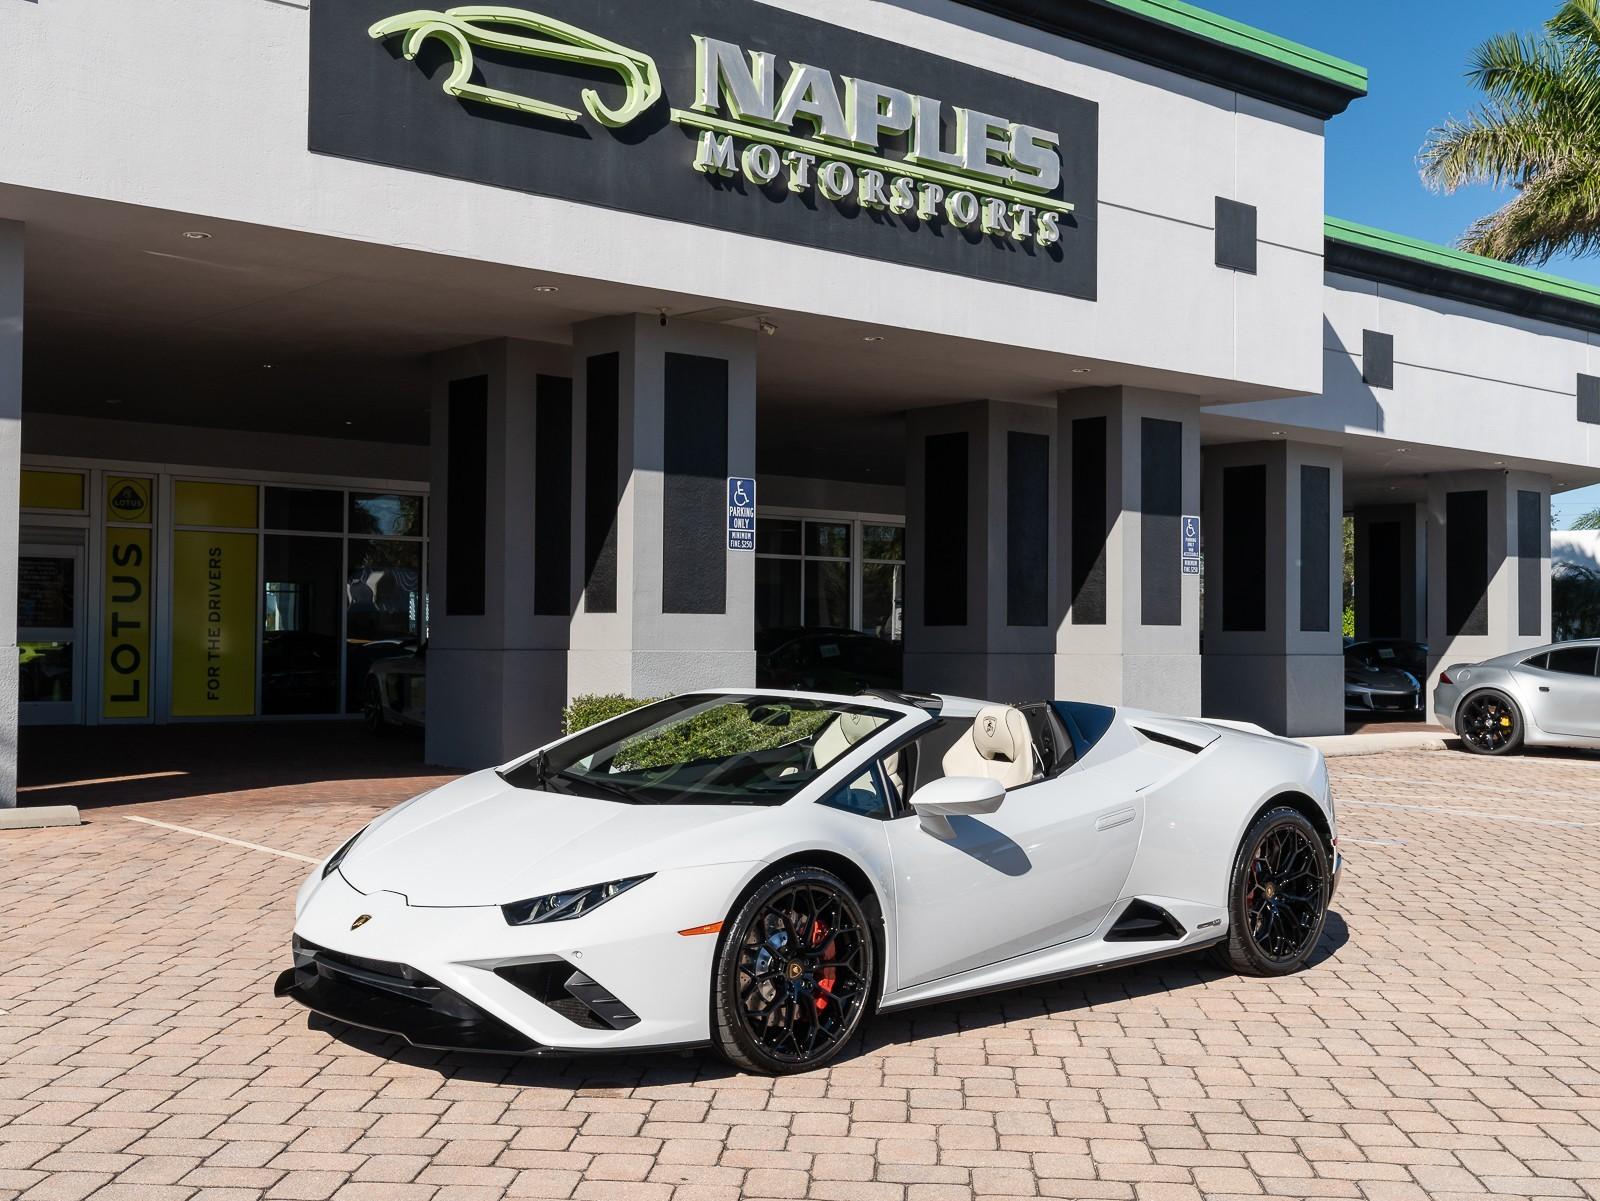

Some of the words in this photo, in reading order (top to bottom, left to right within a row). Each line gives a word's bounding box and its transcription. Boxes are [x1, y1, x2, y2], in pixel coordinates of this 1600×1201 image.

[690, 33, 1061, 194] NAPLES
[692, 130, 1060, 247] MOTORSPORTS
[115, 499, 141, 507] LOTUS
[729, 506, 754, 518] PARKING
[733, 518, 750, 529] ONLY
[208, 547, 222, 622] DRIVERS
[110, 543, 143, 702] LOTUS
[208, 628, 220, 661] THE
[207, 667, 220, 701] FOR
